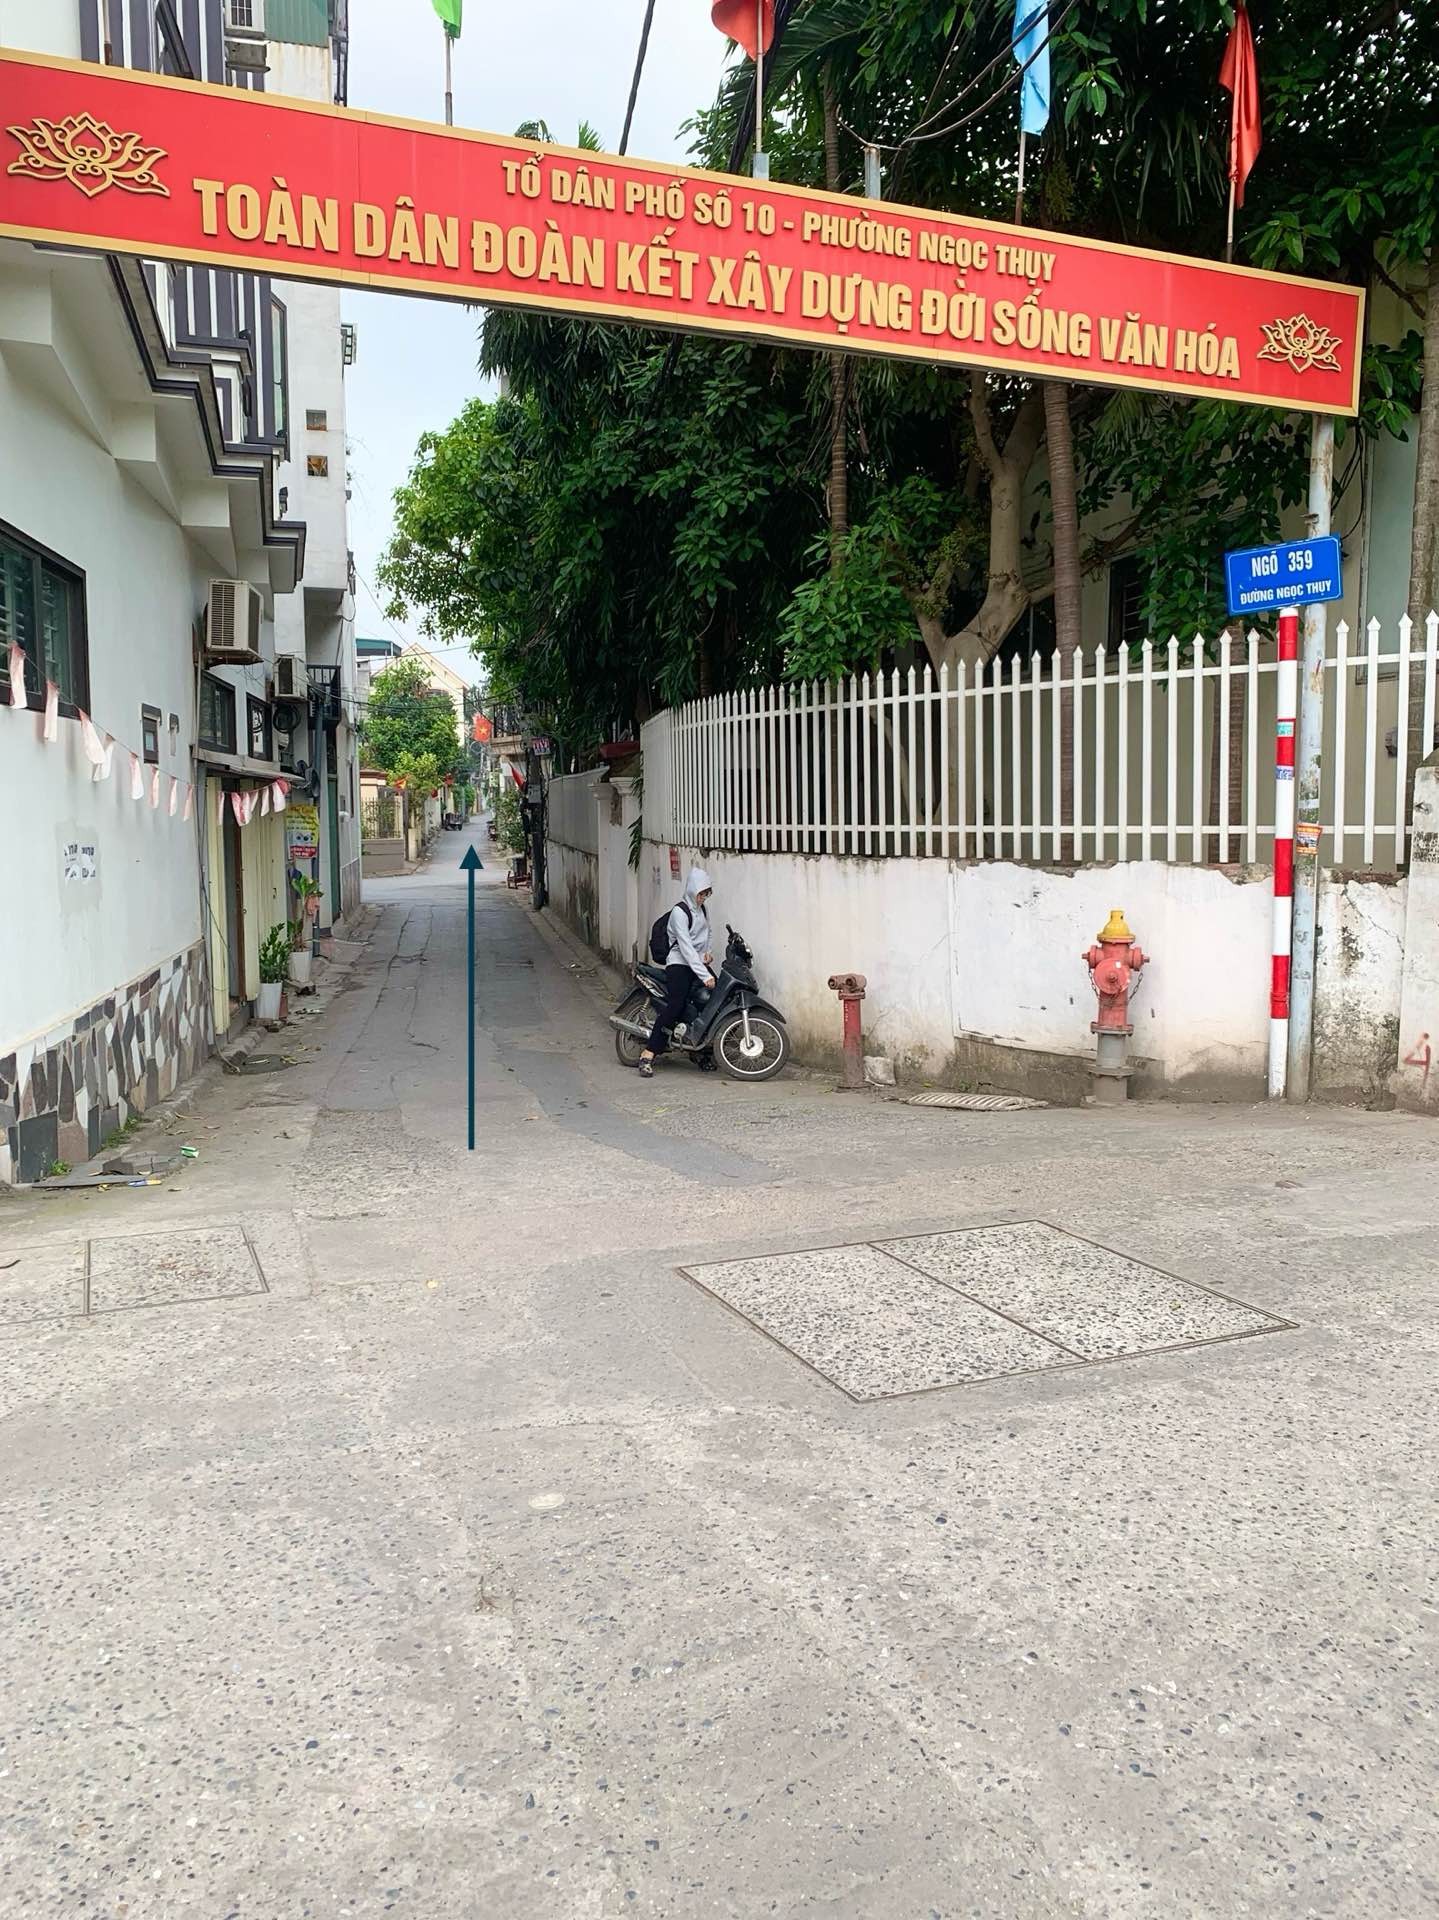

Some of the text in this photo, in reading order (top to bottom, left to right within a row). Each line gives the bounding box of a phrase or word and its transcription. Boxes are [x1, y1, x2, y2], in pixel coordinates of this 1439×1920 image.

[502, 151, 545, 199] TỔ
[551, 165, 616, 211] DÂN
[624, 177, 687, 220] PHỐ
[742, 201, 776, 235] 10
[803, 210, 911, 258] PHƯỜNG
[918, 231, 988, 275] NGỌC
[995, 244, 1056, 286] THỤY
[193, 176, 1241, 379] TOÀN DÂN ĐOÀN KẾT XÂY DỰNG ĐỜI SỐNG VĂN HÓA
[1240, 579, 1332, 605] ĐƯỜNG NGỌC THỤY
[1251, 549, 1313, 578] NGÕ 359
